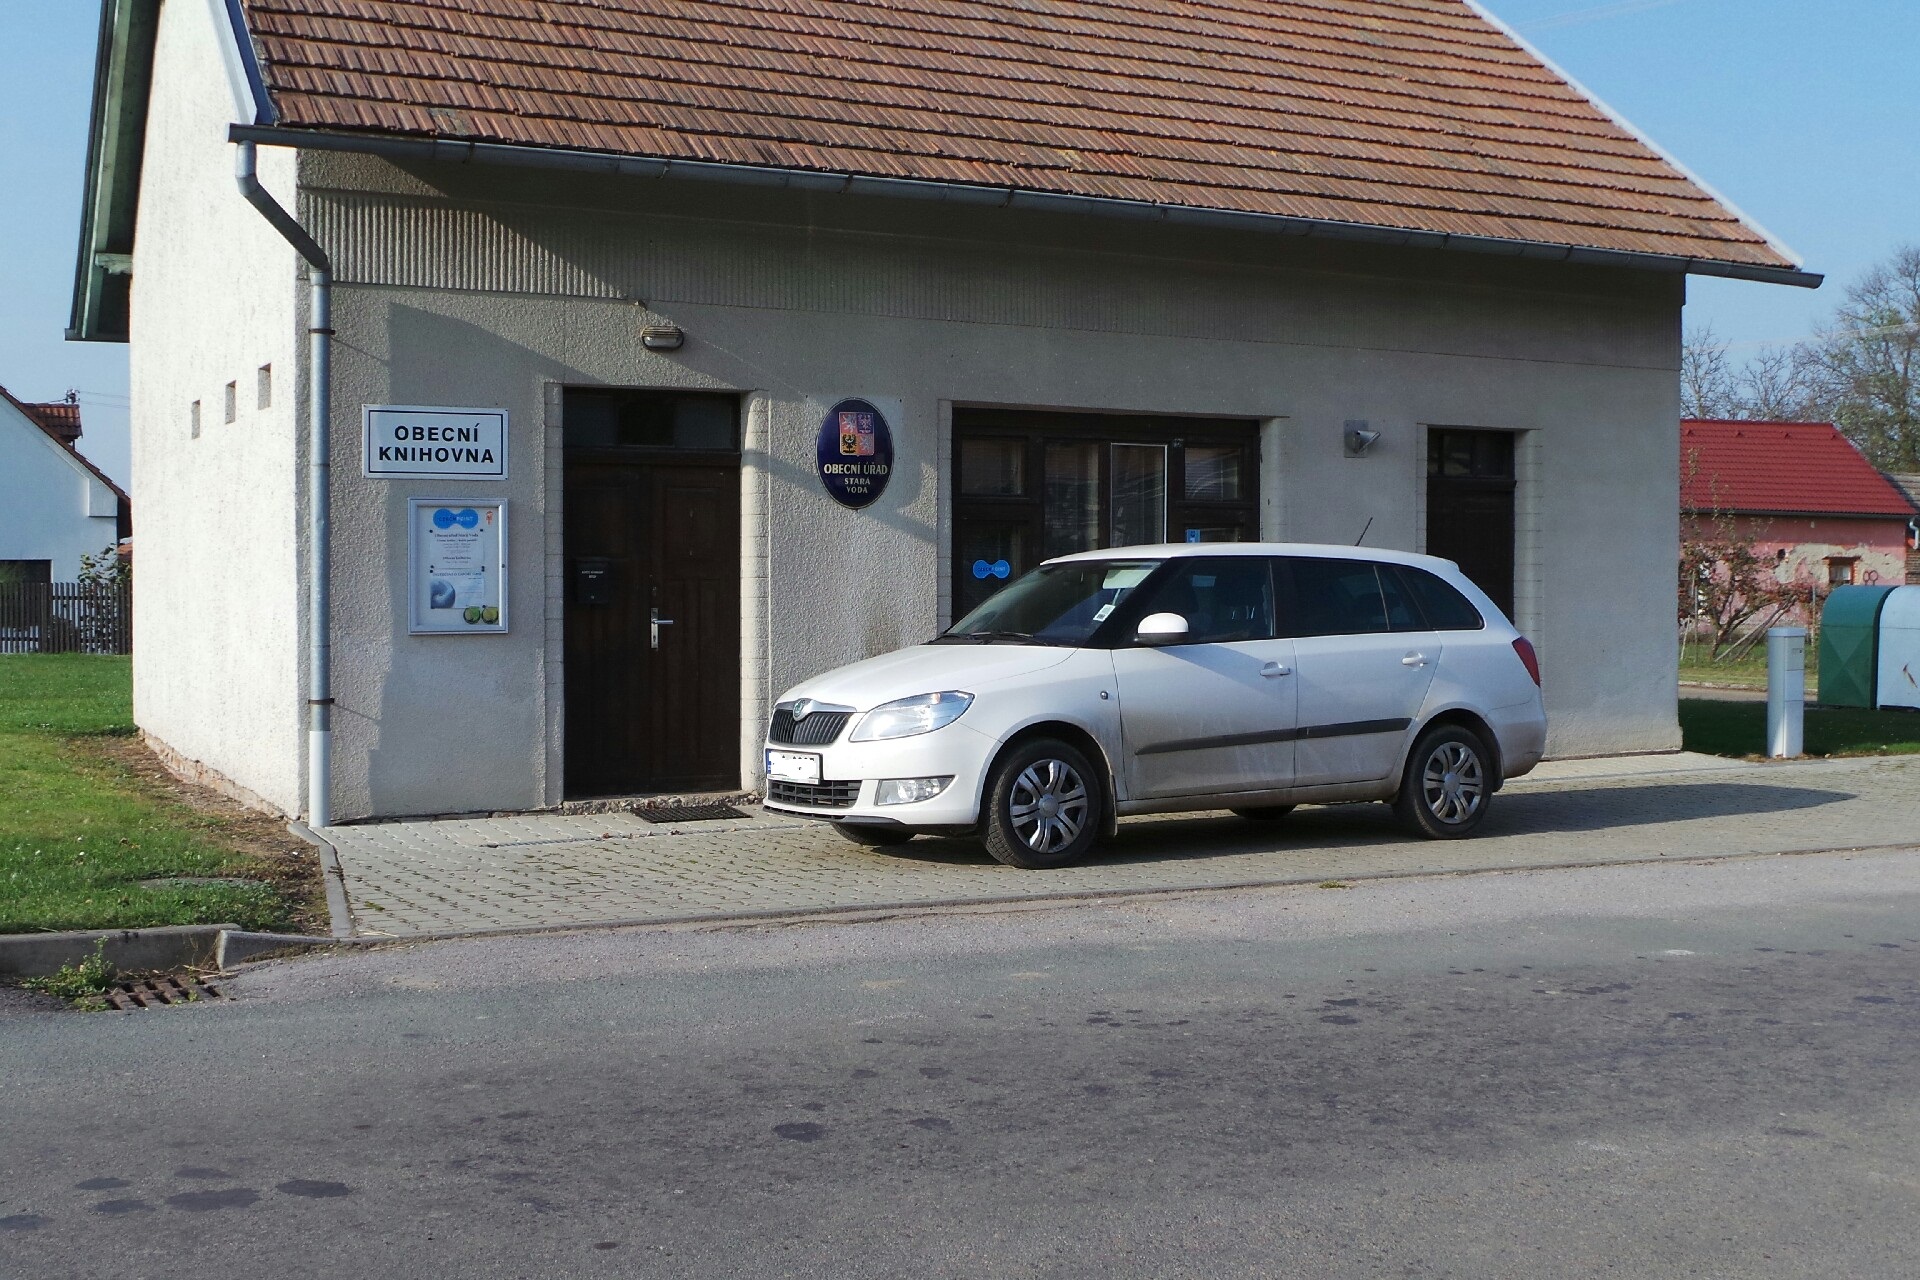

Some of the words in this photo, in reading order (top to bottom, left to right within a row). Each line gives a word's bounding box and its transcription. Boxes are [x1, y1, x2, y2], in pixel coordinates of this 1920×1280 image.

[394, 423, 480, 442] OBECNÍ
[379, 446, 494, 463] KNIHOVNA
[823, 462, 860, 475] OBECNÍ
[863, 462, 888, 475] ÚŘAD
